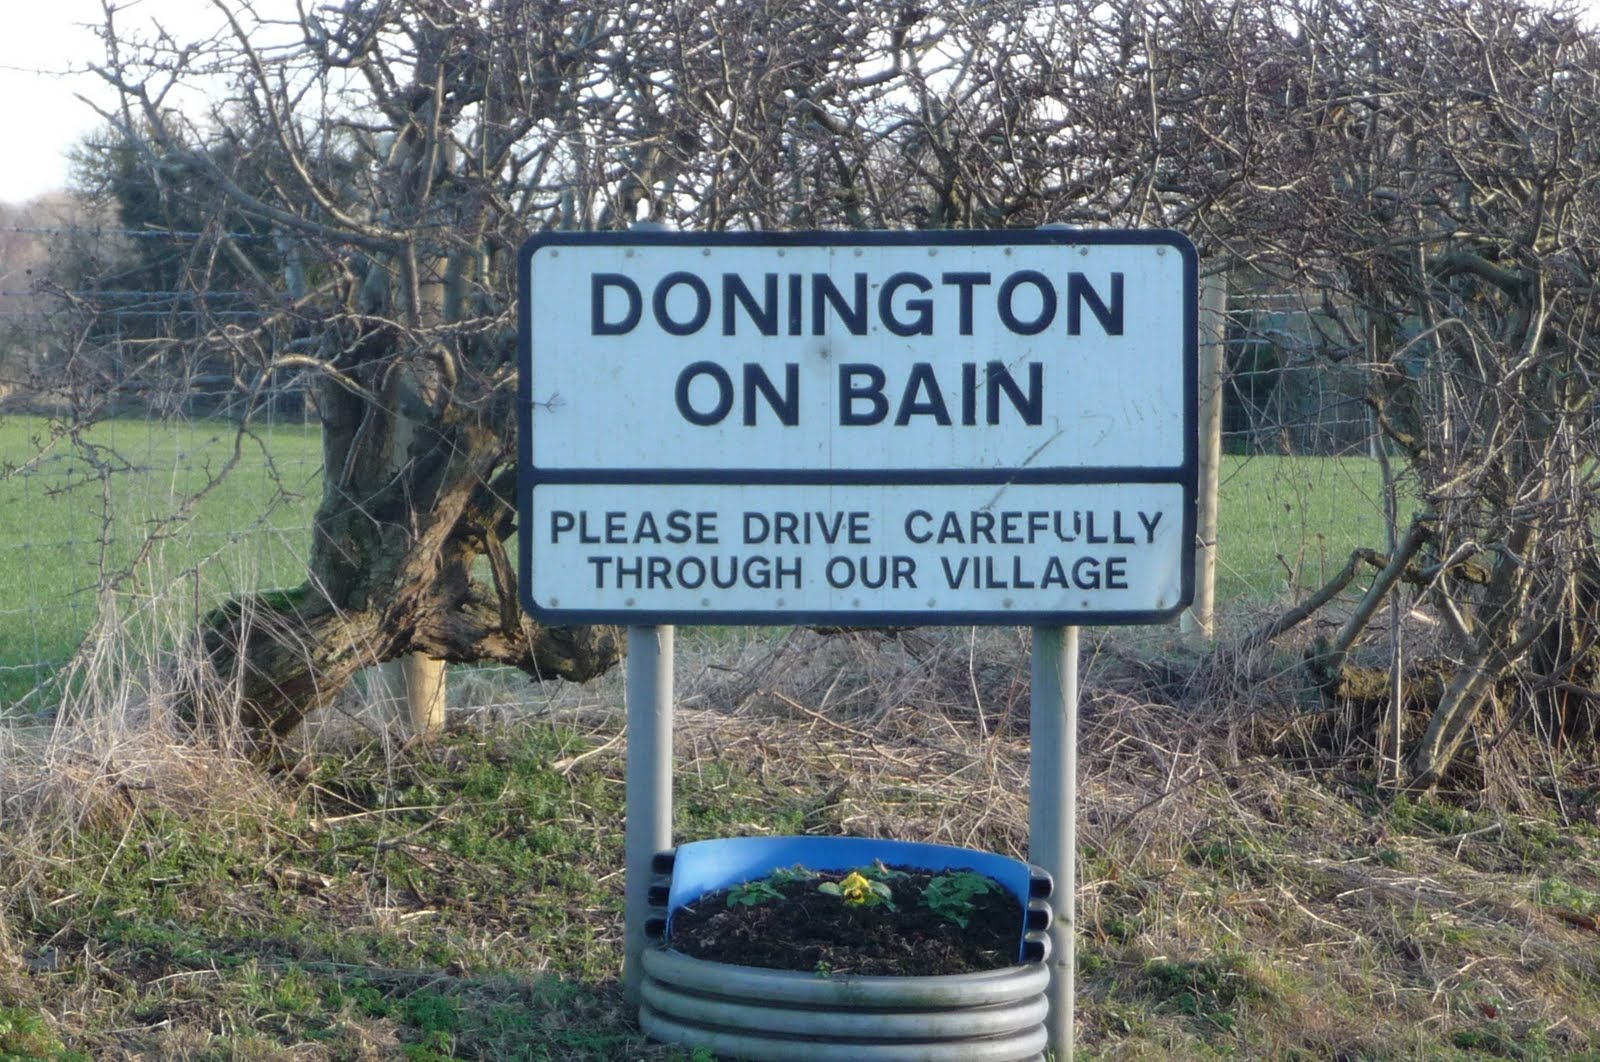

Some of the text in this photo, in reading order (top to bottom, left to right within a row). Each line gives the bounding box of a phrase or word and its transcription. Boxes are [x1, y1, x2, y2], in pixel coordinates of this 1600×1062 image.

[591, 270, 1125, 337] DONINGTON
[674, 361, 1044, 427] ON BAIN
[550, 510, 1163, 545] PLEASE DRIVE CAREFULLY
[587, 555, 1129, 591] THROUGH OUR VILLAGE
